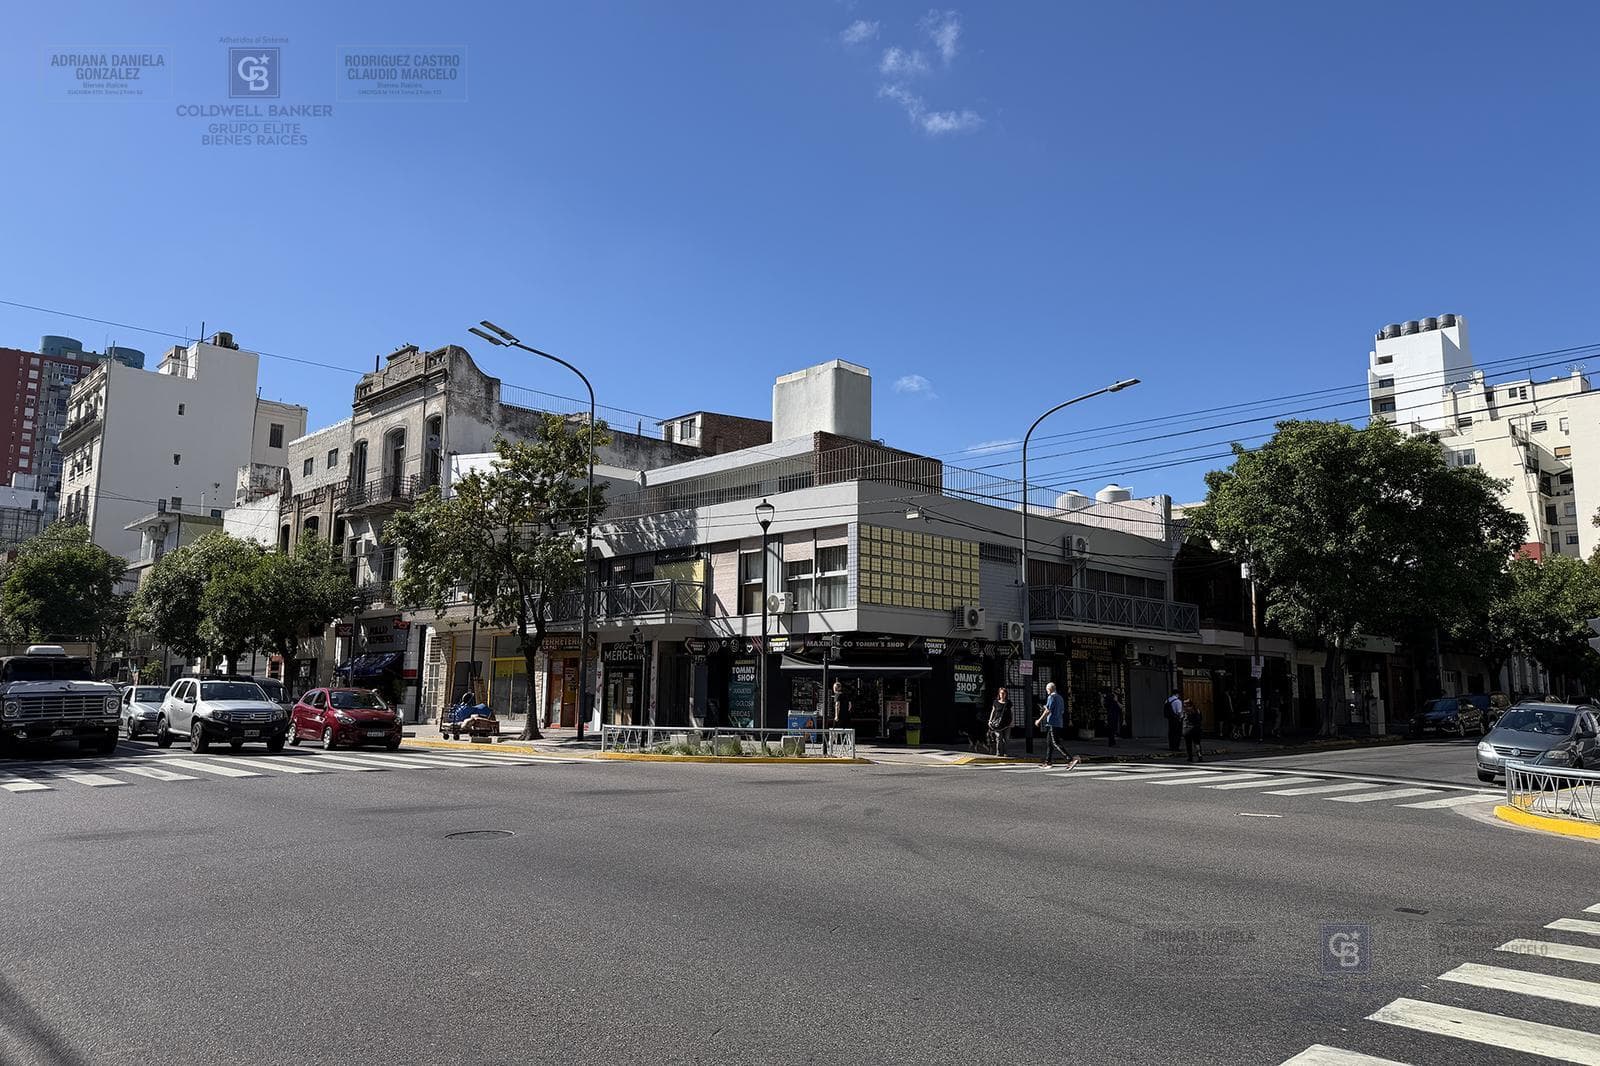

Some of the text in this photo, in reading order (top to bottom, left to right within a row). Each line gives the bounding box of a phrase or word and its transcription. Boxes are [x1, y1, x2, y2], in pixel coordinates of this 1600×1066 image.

[541, 637, 582, 648] FERRETERI
[856, 641, 885, 649] TOMMY'S
[887, 641, 905, 649] SHOP
[737, 674, 755, 682] SHOP
[956, 682, 977, 691] SHOP
